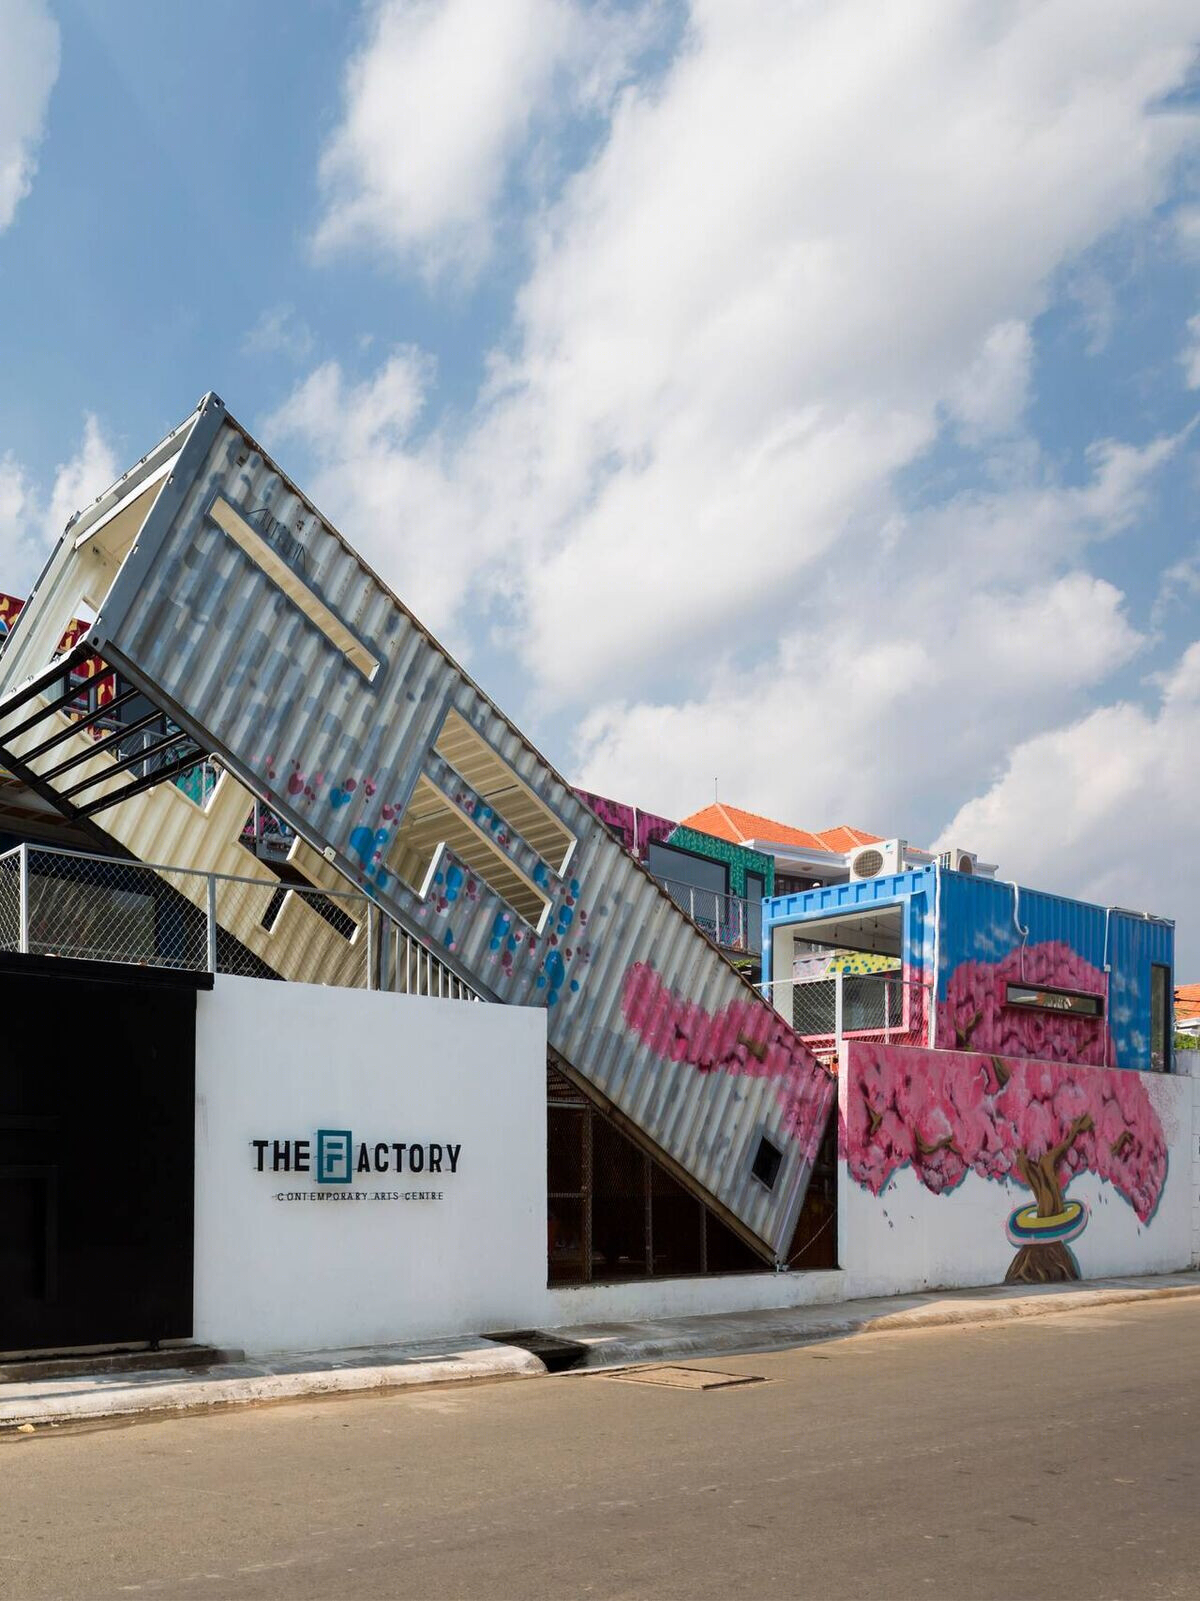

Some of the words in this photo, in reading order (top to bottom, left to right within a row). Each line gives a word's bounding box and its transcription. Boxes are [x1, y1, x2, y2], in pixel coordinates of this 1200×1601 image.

[252, 1139, 311, 1172] THE
[318, 1132, 462, 1179] FACTORY
[277, 1192, 368, 1202] CONTEMPORARY
[374, 1192, 399, 1201] ARTS
[404, 1191, 444, 1201] CENTRE
